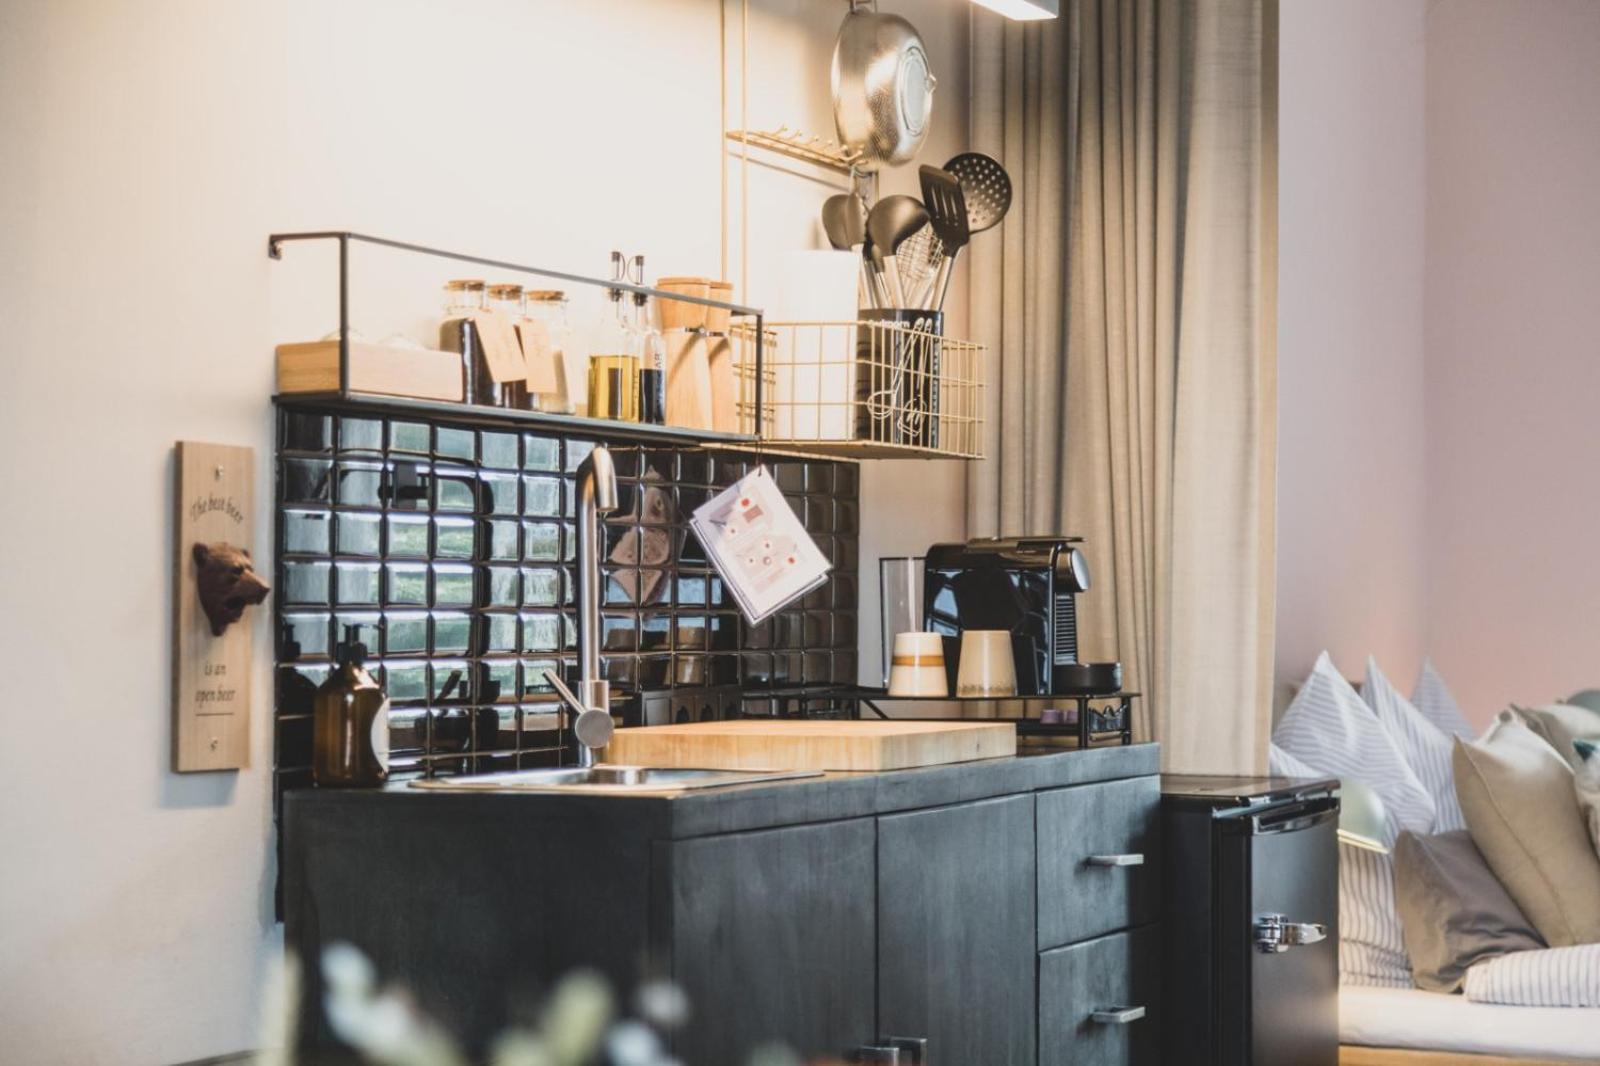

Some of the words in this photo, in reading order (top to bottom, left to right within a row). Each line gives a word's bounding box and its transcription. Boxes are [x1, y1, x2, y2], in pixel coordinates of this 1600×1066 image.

[190, 496, 207, 521] The
[204, 660, 213, 676] is
[214, 664, 226, 676] an
[195, 690, 215, 709] open
